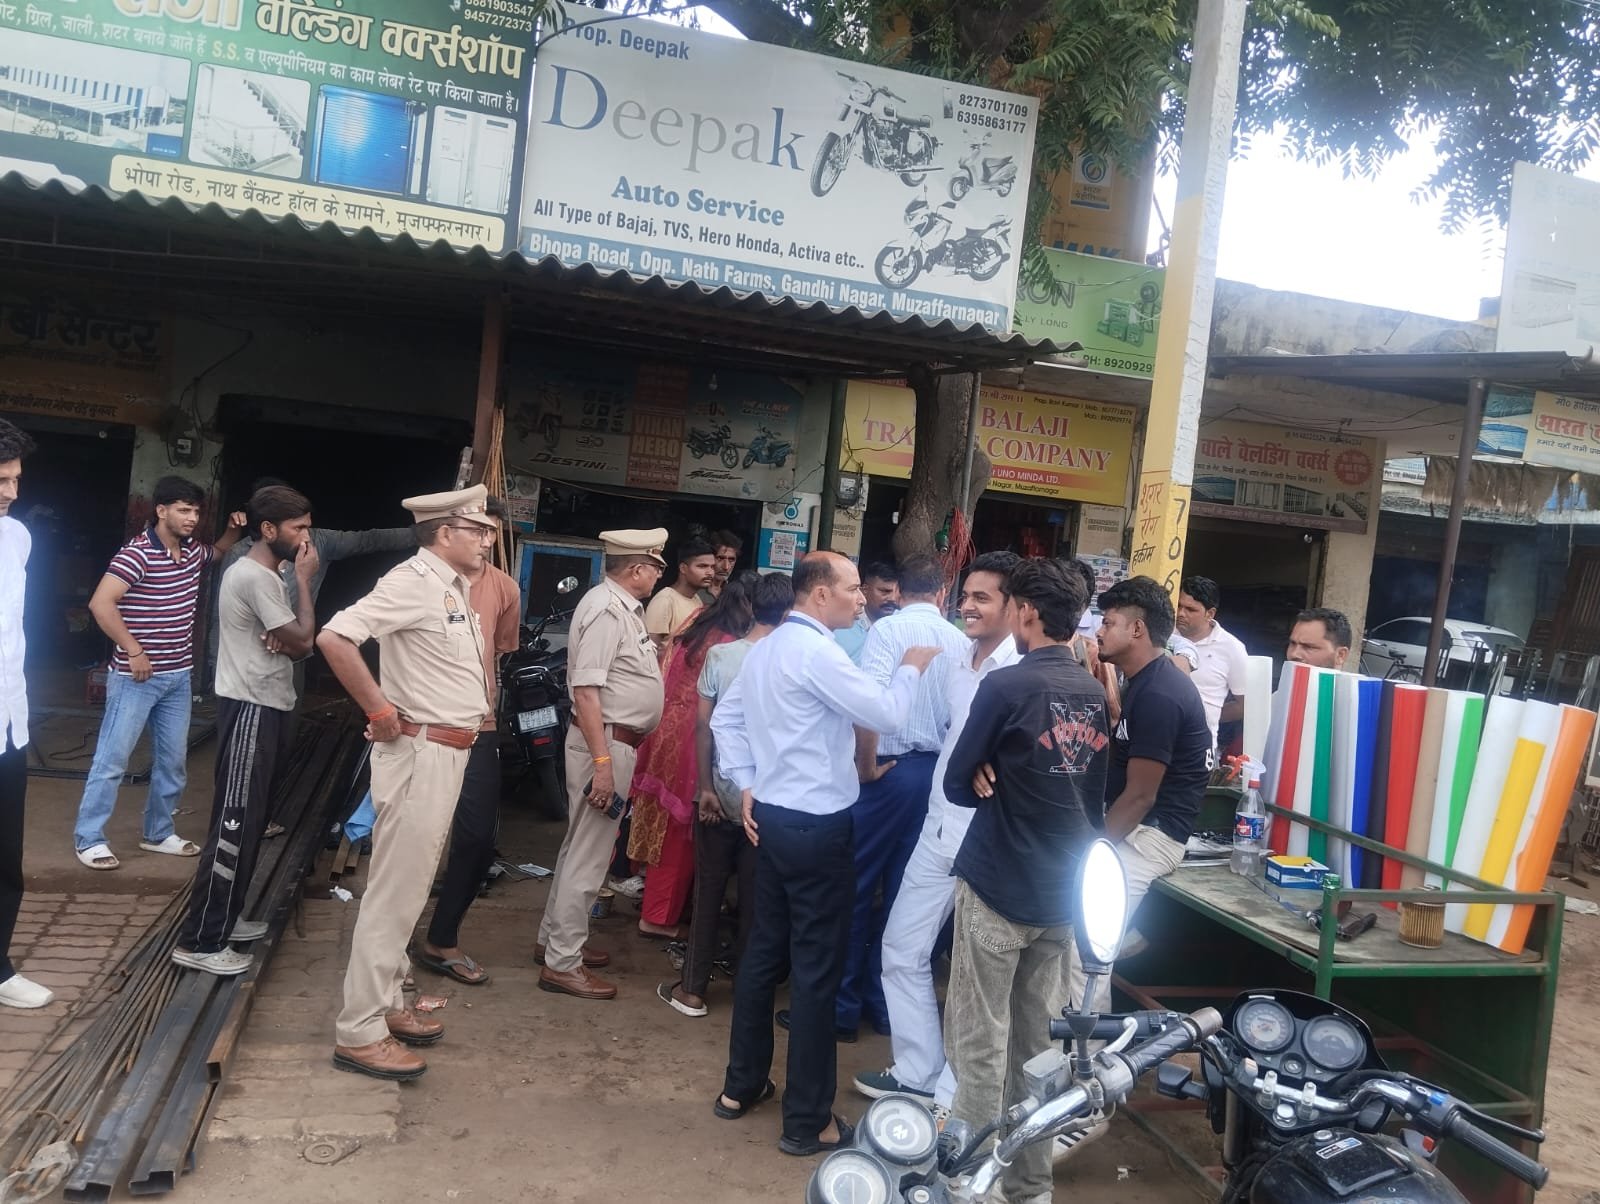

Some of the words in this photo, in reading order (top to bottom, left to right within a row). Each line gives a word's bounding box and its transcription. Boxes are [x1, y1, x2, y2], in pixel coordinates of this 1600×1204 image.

[464, 9, 532, 32] 9457272373
[562, 18, 611, 46] Prop.
[620, 28, 691, 60] Deepak
[102, 23, 130, 41] शटर
[169, 31, 193, 51] जाते
[212, 40, 240, 61] S.S.
[244, 47, 256, 63] व
[330, 63, 347, 80] का
[350, 67, 376, 85] काम
[378, 67, 406, 92] लेबर
[408, 73, 424, 94] रेट
[427, 83, 442, 99] पर
[445, 81, 474, 103] किया
[476, 91, 503, 110] जाता
[541, 64, 806, 173] Deepak
[957, 110, 1026, 134] 6395863177
[958, 93, 1028, 117] 8273701709
[124, 162, 162, 187] भोपा
[206, 179, 238, 199] नाथ
[288, 190, 318, 213] हॉल
[322, 194, 340, 216] के
[611, 175, 680, 207] Auto
[686, 188, 785, 226] Service
[533, 198, 554, 216] All
[558, 202, 592, 223] Type
[597, 210, 612, 227] of
[616, 212, 657, 237] Bajaj,
[663, 220, 694, 243] TVS,
[698, 226, 731, 247] Hero
[735, 233, 784, 258] Honda,
[788, 241, 830, 264] Activa
[529, 232, 582, 260] Bhopa
[587, 241, 634, 271] Road,
[639, 251, 676, 276] Opp.
[681, 257, 719, 281] Nath
[724, 264, 776, 293] Farms,
[781, 273, 835, 300] Gandhi
[892, 292, 1000, 325] Muzaffarnagar
[1104, 356, 1154, 373] 8920929
[980, 406, 1070, 439] BALAJI
[1538, 414, 1588, 437] भारत
[632, 434, 680, 458] HERO
[987, 436, 1113, 471] COMPANY
[997, 468, 1016, 479] UNO
[1017, 471, 1044, 482] MINDA
